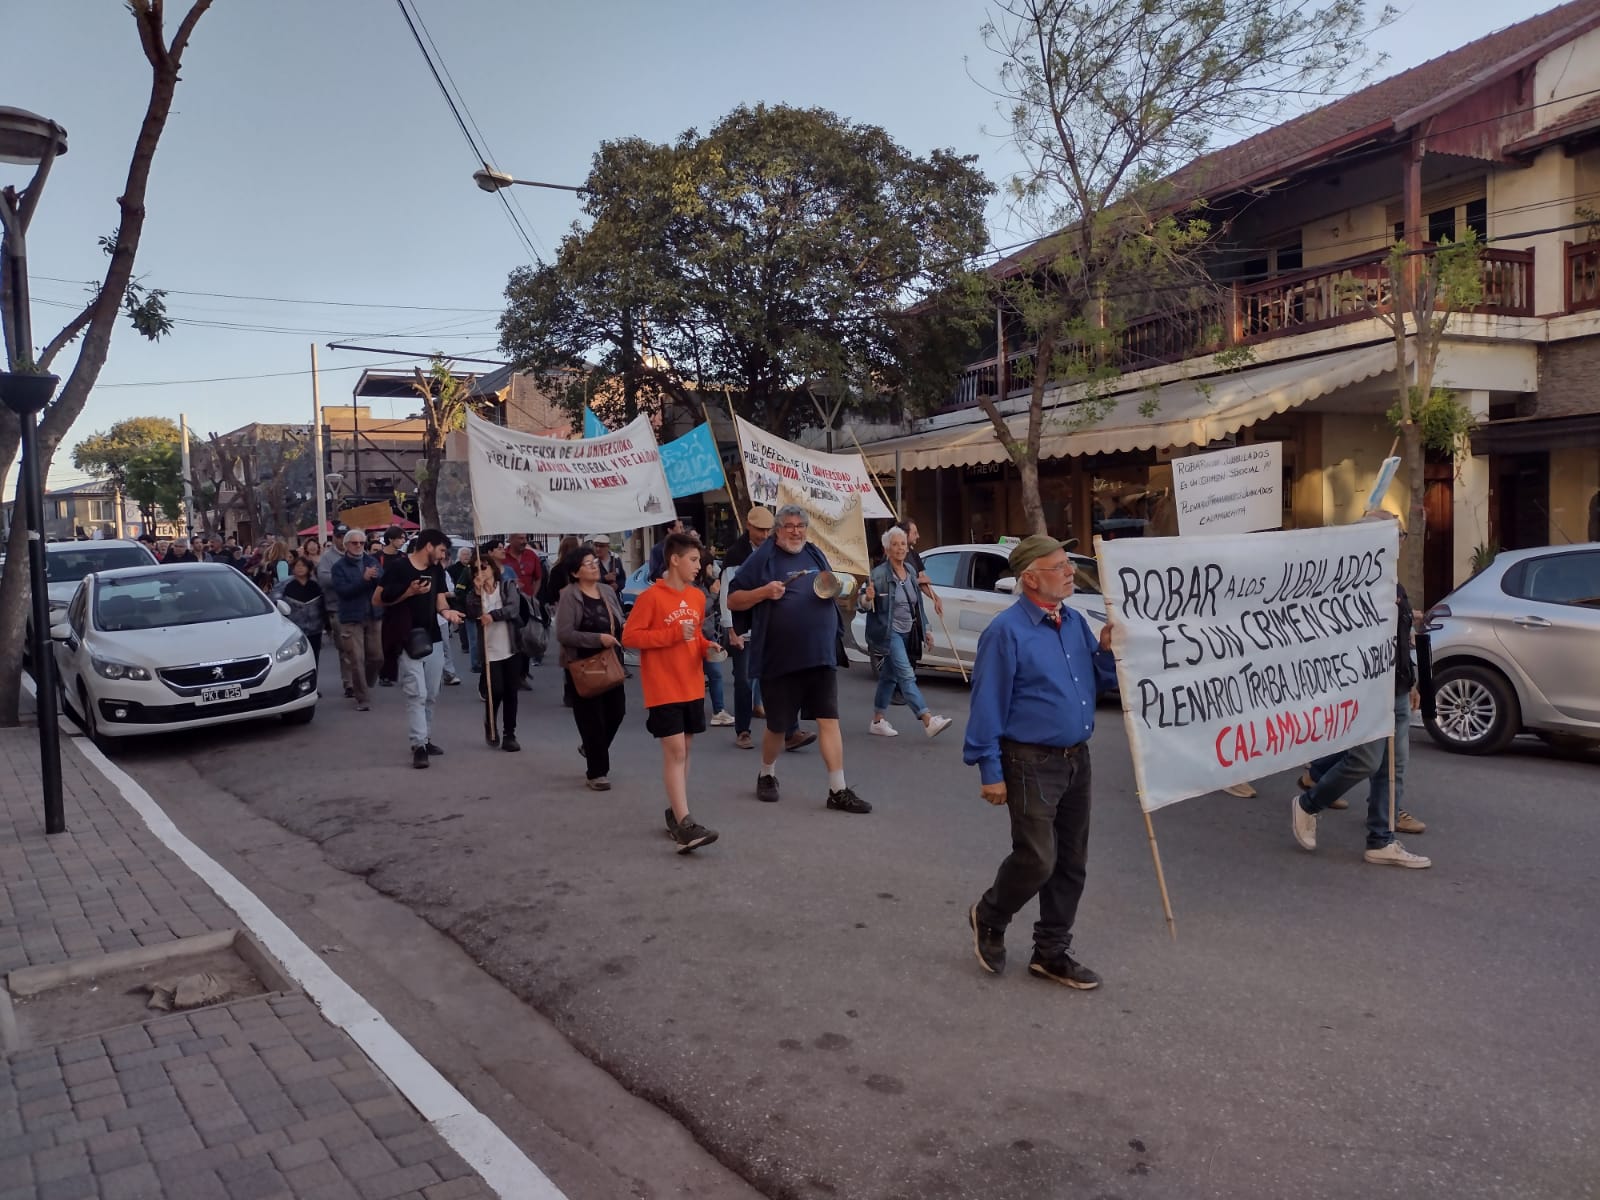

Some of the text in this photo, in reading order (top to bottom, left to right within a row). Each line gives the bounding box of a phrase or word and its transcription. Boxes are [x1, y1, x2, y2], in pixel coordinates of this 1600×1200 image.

[560, 446, 572, 459] DE
[573, 445, 585, 458] LA
[611, 459, 620, 470] Y
[618, 456, 633, 468] DE
[801, 461, 811, 474] LA
[550, 477, 583, 491] LUCHA
[583, 477, 590, 490] Y
[1118, 548, 1386, 621] ROBAR A LOS JUBILADOS
[1158, 591, 1389, 670] ES UN CRIMEN SOCIAL
[1137, 675, 1243, 729] PLENARIO
[1239, 652, 1360, 711] TRABAJADORES
[1215, 699, 1360, 768] CALAMUCHITA
